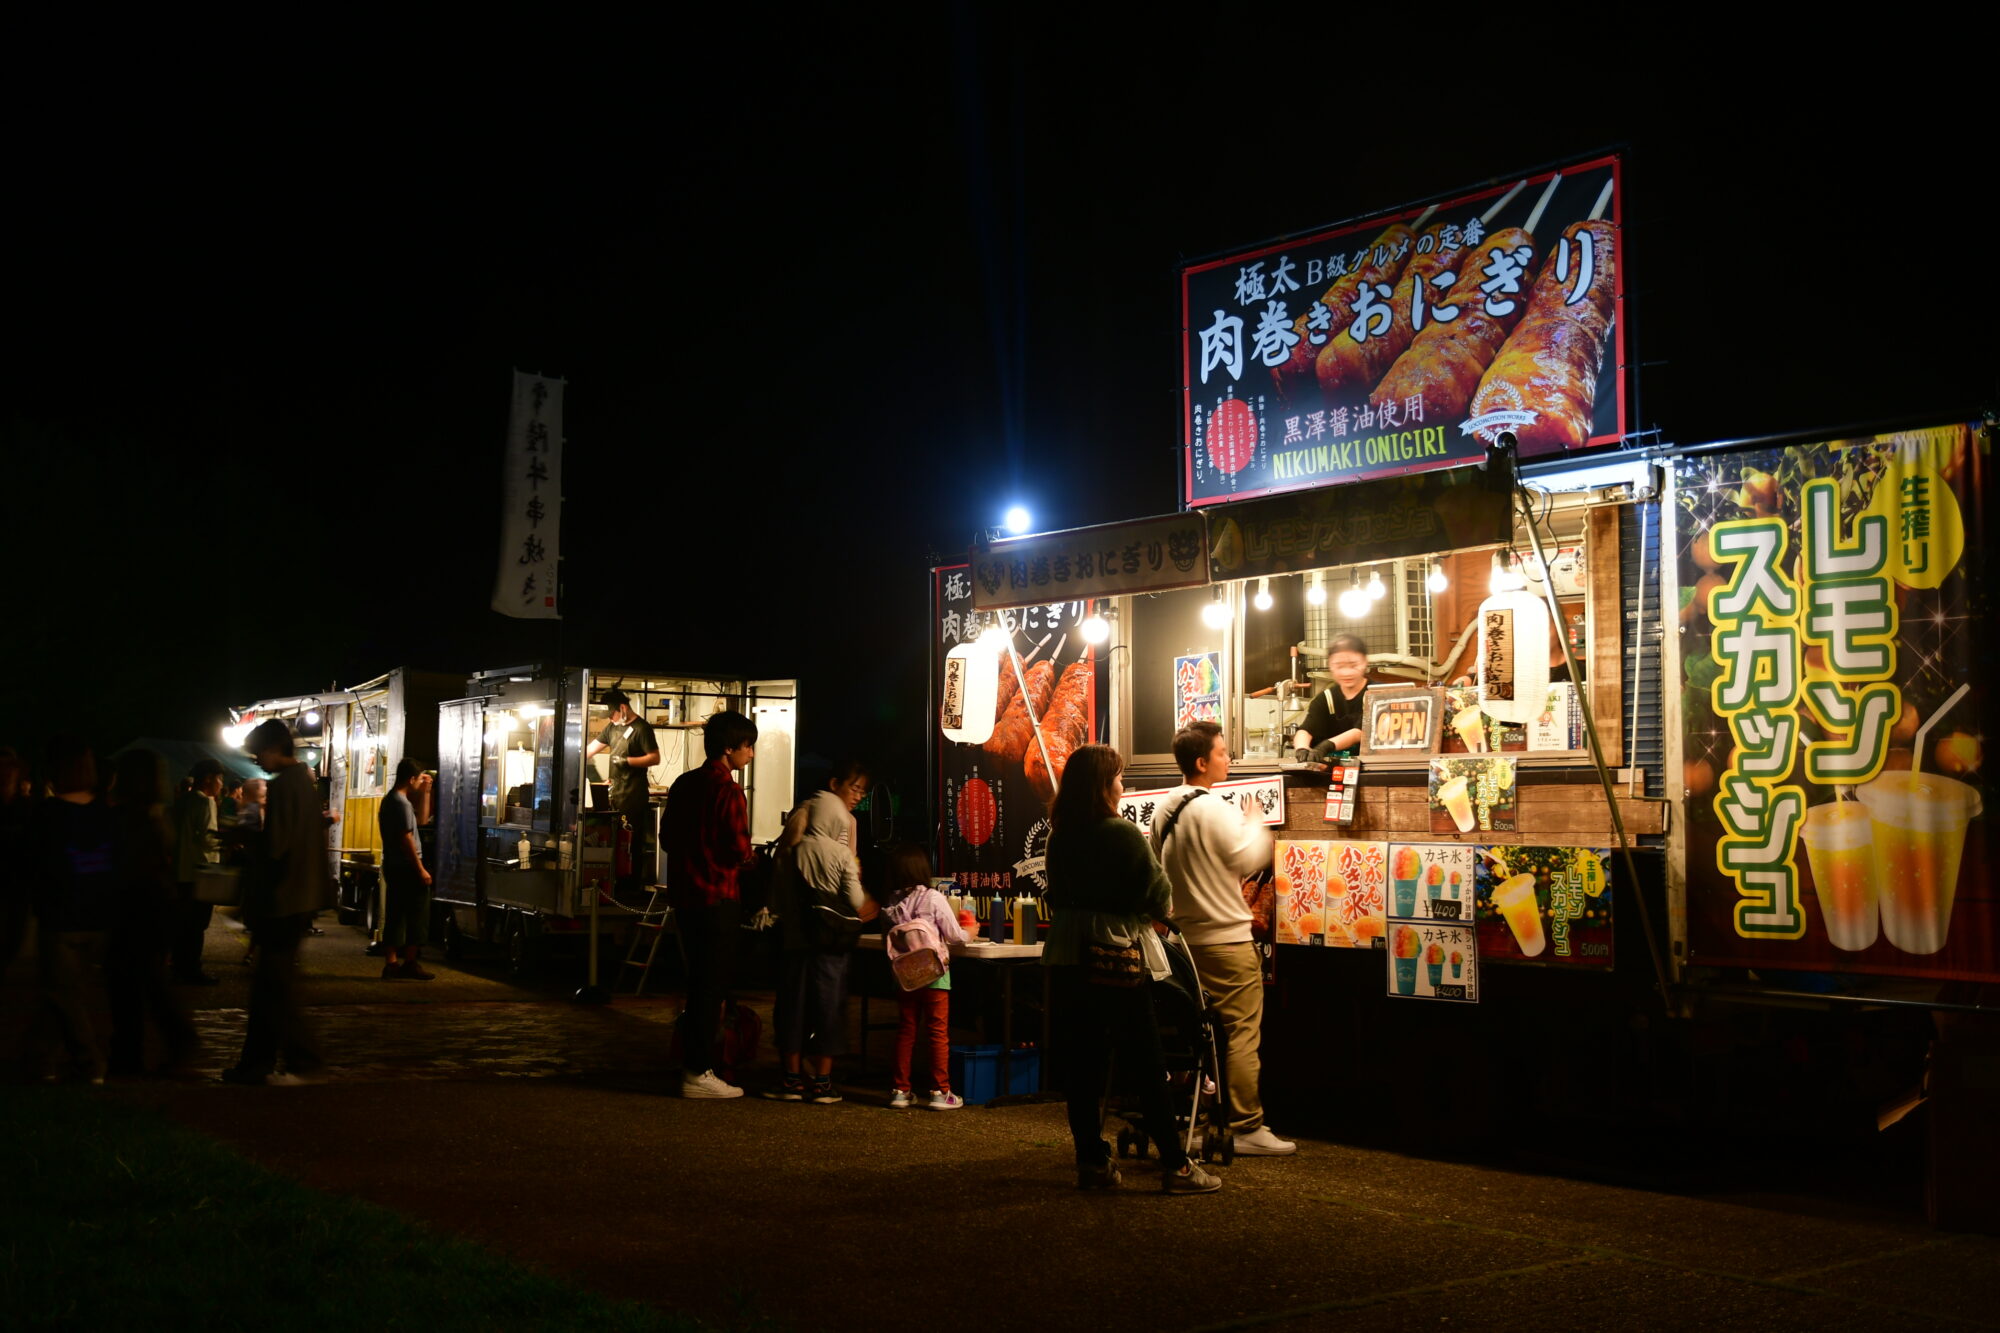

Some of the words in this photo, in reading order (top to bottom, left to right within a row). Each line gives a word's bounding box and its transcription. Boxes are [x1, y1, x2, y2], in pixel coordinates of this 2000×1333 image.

[1306, 217, 1485, 286] B級グルメの定番
[1198, 230, 1596, 385] 肉巻きおにぎり
[1234, 256, 1300, 306] 極太
[1283, 393, 1424, 445] 黒澤醤油使用
[1272, 440, 1363, 480] NIKUMAKI
[1366, 425, 1448, 465] ONIGIRI
[1899, 474, 1932, 574] 生搾り
[1009, 540, 1163, 590] 肉巻きおにぎり
[1486, 613, 1505, 697] 肉巻きおにぎり
[1805, 482, 1897, 780] レモン
[1377, 711, 1427, 741] OPEN
[1713, 522, 1802, 936] スカッシュ
[1285, 846, 1311, 922] かき氷
[1307, 846, 1324, 902] みかん
[1364, 847, 1383, 904] みかん
[1425, 849, 1462, 864] カキ氷
[1339, 847, 1370, 924] かき氷
[1550, 872, 1571, 956] スカッシュ
[1567, 864, 1584, 919] レモン
[1423, 929, 1462, 944] カキ氷
